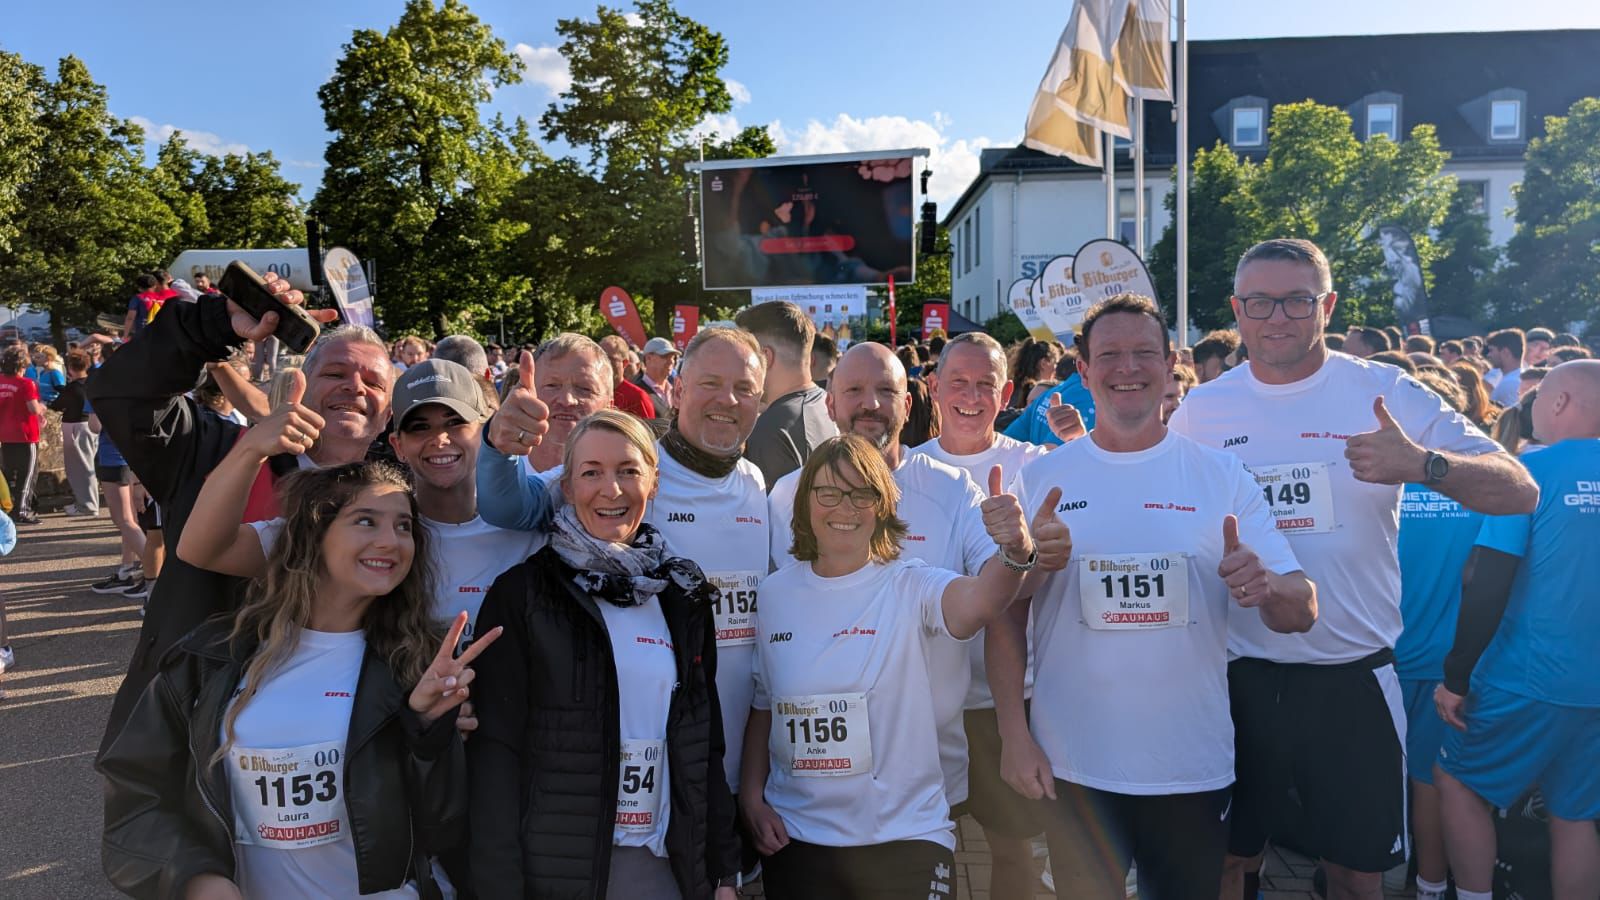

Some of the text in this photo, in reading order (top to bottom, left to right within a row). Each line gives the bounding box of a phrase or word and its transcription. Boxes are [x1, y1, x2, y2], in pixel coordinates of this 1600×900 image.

[1082, 268, 1138, 288] Bitburger
[1223, 435, 1249, 449] JAKO
[1263, 482, 1311, 507] 149
[1058, 500, 1088, 513] JAKO
[667, 512, 695, 523] JAKO
[1100, 559, 1140, 573] Bitburger
[1101, 574, 1165, 598] 1151
[1119, 601, 1151, 609] Markus
[1113, 612, 1169, 623] BAUHAUS
[769, 632, 793, 644] JAKO
[783, 702, 819, 717] Bitburger
[786, 716, 848, 744] 1156
[806, 747, 827, 755] Anke
[250, 755, 299, 775] Bitburger
[798, 758, 850, 770] BAUHAUS
[622, 765, 655, 794] 54
[255, 770, 338, 808] 1153
[278, 811, 310, 822] Laura
[269, 820, 340, 839] BAUHAUS
